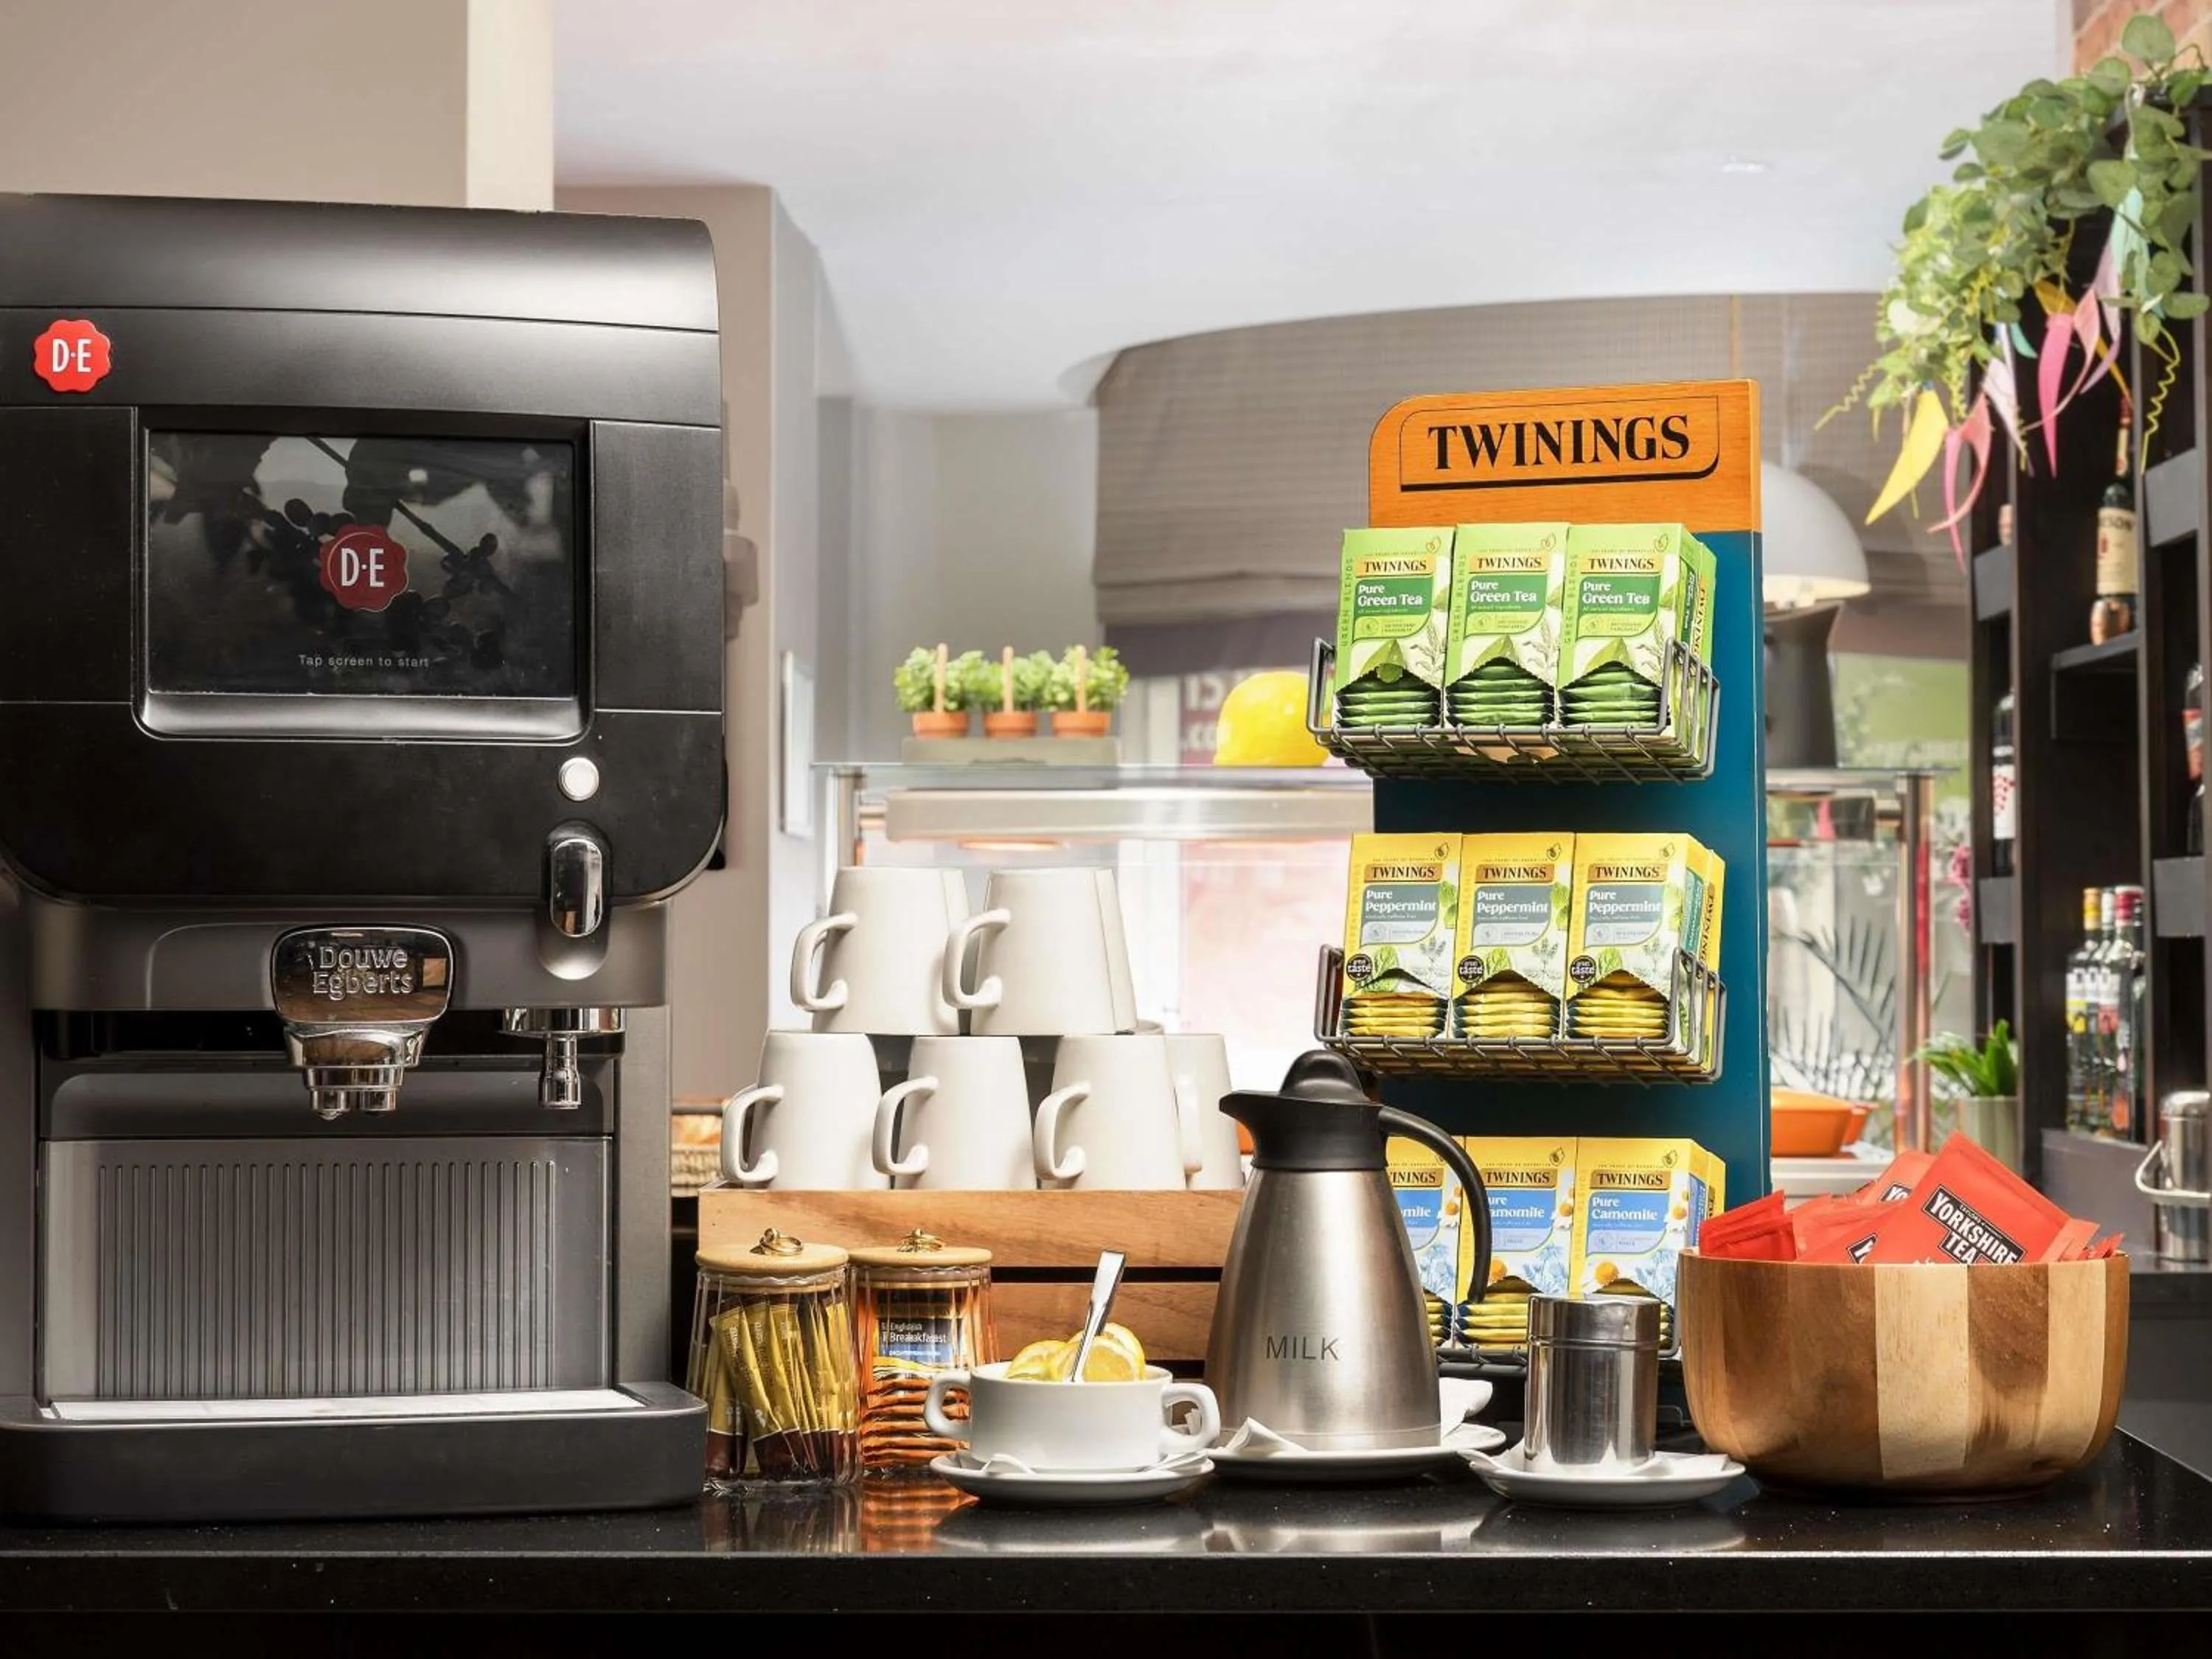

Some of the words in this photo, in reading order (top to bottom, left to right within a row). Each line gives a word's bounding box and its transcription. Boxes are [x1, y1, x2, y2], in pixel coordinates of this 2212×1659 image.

[1427, 414, 1690, 470] TWININGS
[1364, 560, 1427, 573] TWININGS
[1477, 557, 1543, 569] TWININGS
[1588, 557, 1655, 570] TWININGS
[1358, 585, 1385, 594] Pure
[1471, 580, 1500, 591] Pure
[1582, 581, 1612, 591] Pure
[1357, 594, 1397, 607] Green
[1399, 593, 1423, 605] Tea
[1470, 591, 1511, 602] Green
[1513, 591, 1537, 602] Tea
[1582, 594, 1623, 605] Green
[1626, 593, 1651, 605] Tea
[298, 655, 323, 668] Tap
[328, 656, 374, 667] screen
[378, 657, 392, 667] to
[397, 657, 430, 667] start
[1371, 866, 1436, 878] TWININGS
[1484, 866, 1547, 879] TWININGS
[1595, 866, 1660, 878] TWININGS
[1366, 890, 1393, 900] Pure
[1478, 891, 1506, 901] Pure
[1589, 890, 1617, 900] Pure
[1366, 900, 1436, 914] Peppermint
[1477, 902, 1548, 915] Peppermint
[1589, 900, 1664, 914] Peppermint
[319, 946, 408, 969] Douwe
[313, 970, 414, 1001] Egberts
[1390, 1171, 1436, 1183] ININGS
[1486, 1171, 1551, 1183] TWININGS
[1597, 1173, 1663, 1186] TWININGS
[1488, 1196, 1508, 1206] ure
[1591, 1197, 1620, 1207] Pure
[1489, 1208, 1545, 1219] amomile
[1591, 1208, 1658, 1221] Camomile
[1945, 1231, 1978, 1264] TEA
[1265, 1335, 1340, 1360] MILK
